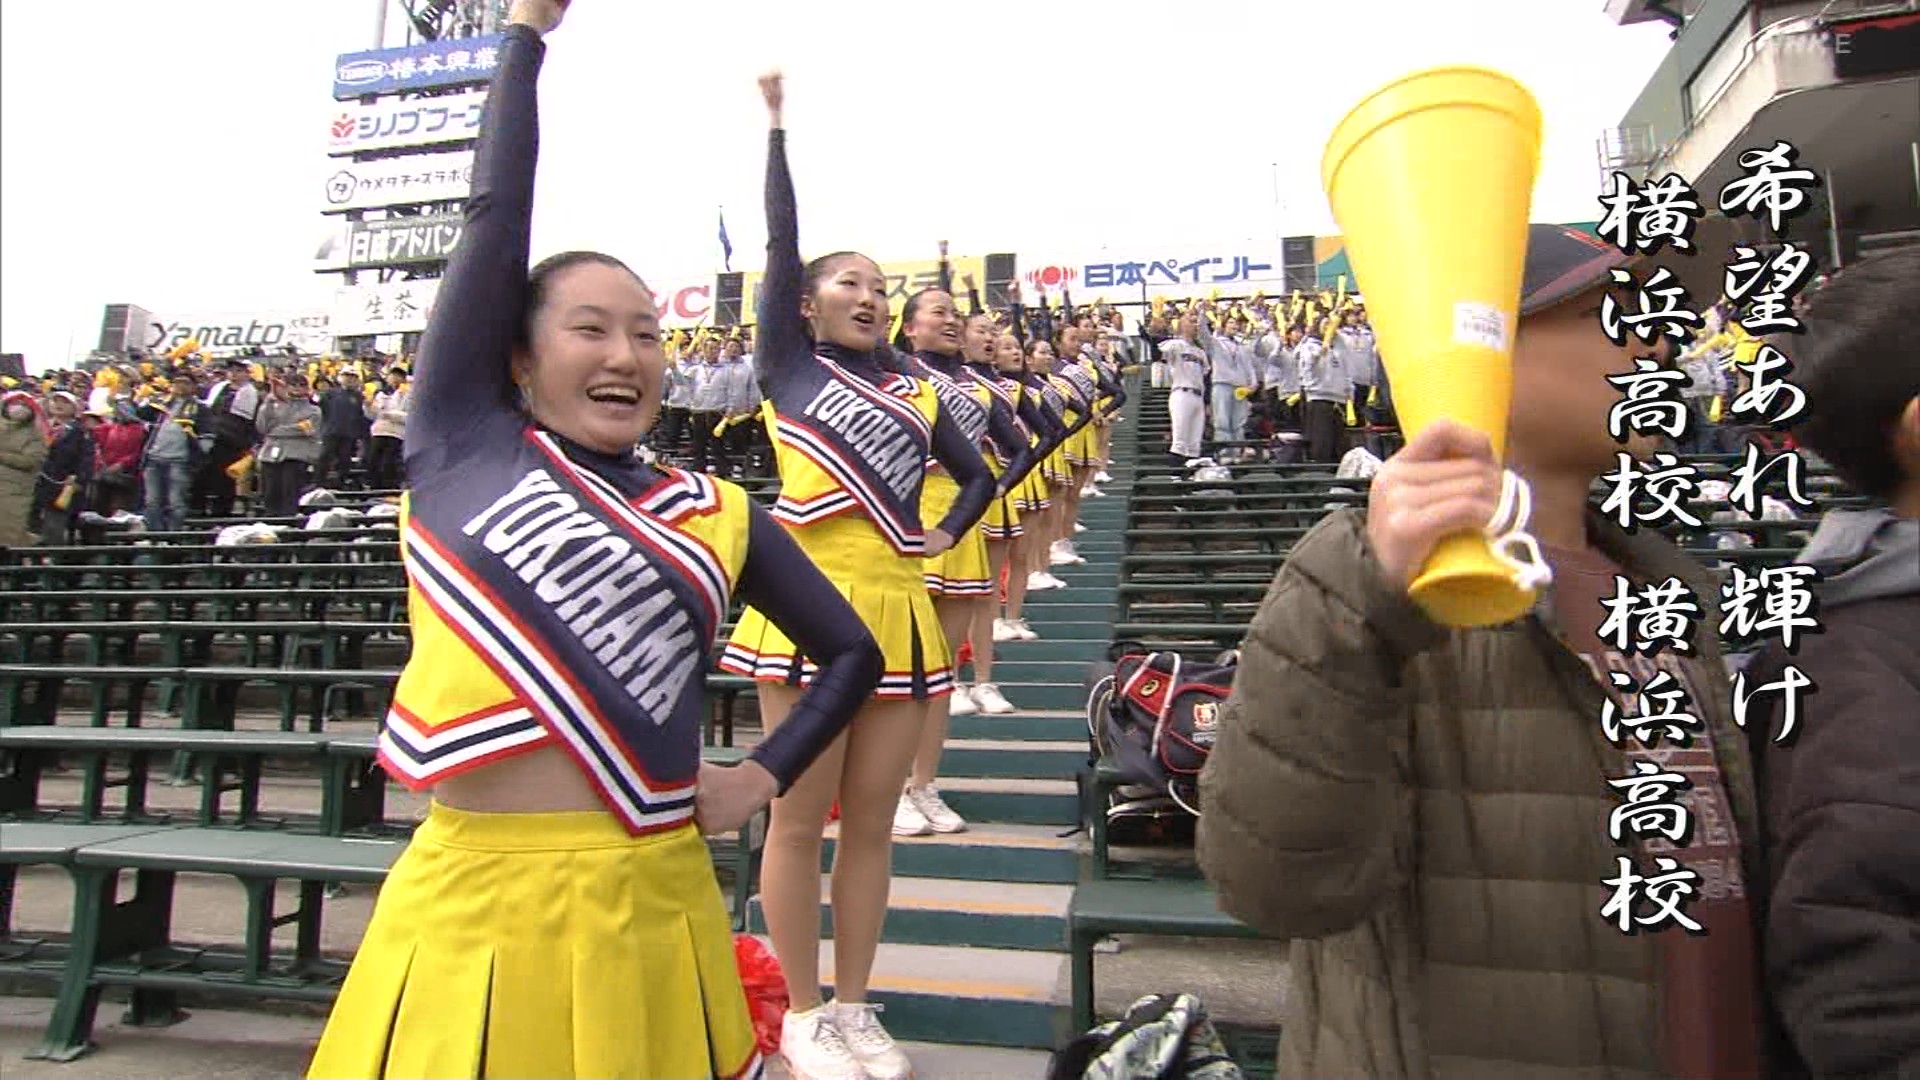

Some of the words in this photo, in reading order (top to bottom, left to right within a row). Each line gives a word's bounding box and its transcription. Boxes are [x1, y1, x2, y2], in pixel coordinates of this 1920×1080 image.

[1084, 256, 1272, 288] 日本ペイント
[365, 289, 419, 322] 生茶
[147, 318, 285, 349] Yamato
[804, 379, 922, 502] YOKOHAMA
[462, 468, 699, 727] YOKOHAMA
